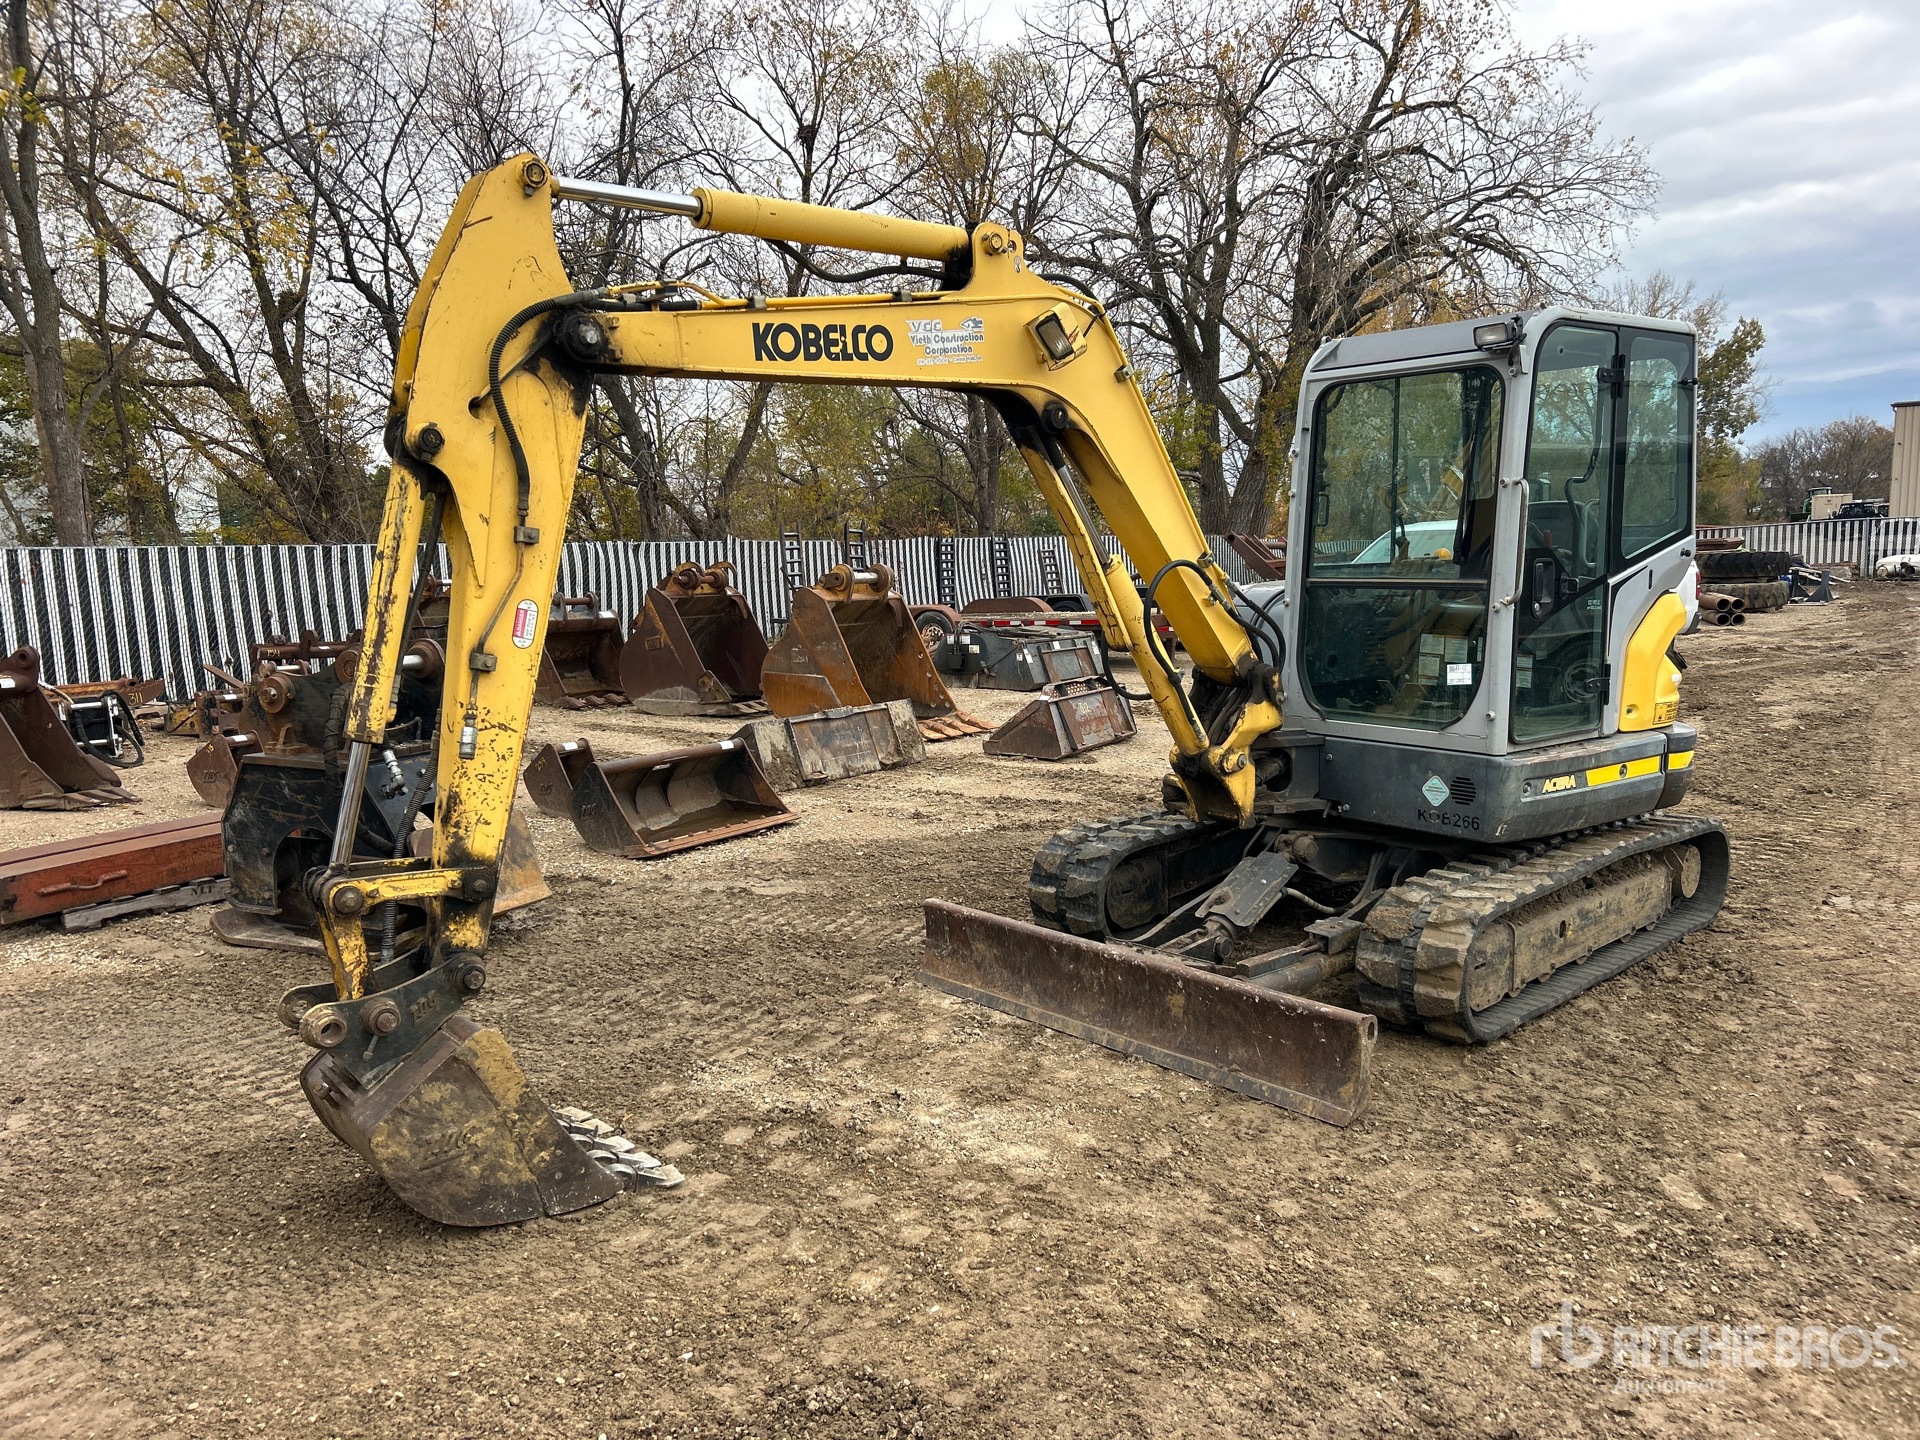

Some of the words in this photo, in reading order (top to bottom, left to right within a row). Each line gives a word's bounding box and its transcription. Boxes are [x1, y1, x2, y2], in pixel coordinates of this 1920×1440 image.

[911, 321, 942, 333] VCC
[752, 323, 894, 361] KOBELCO
[933, 332, 984, 344] Construction
[924, 344, 973, 356] Corporation
[1541, 774, 1577, 794] ACERA
